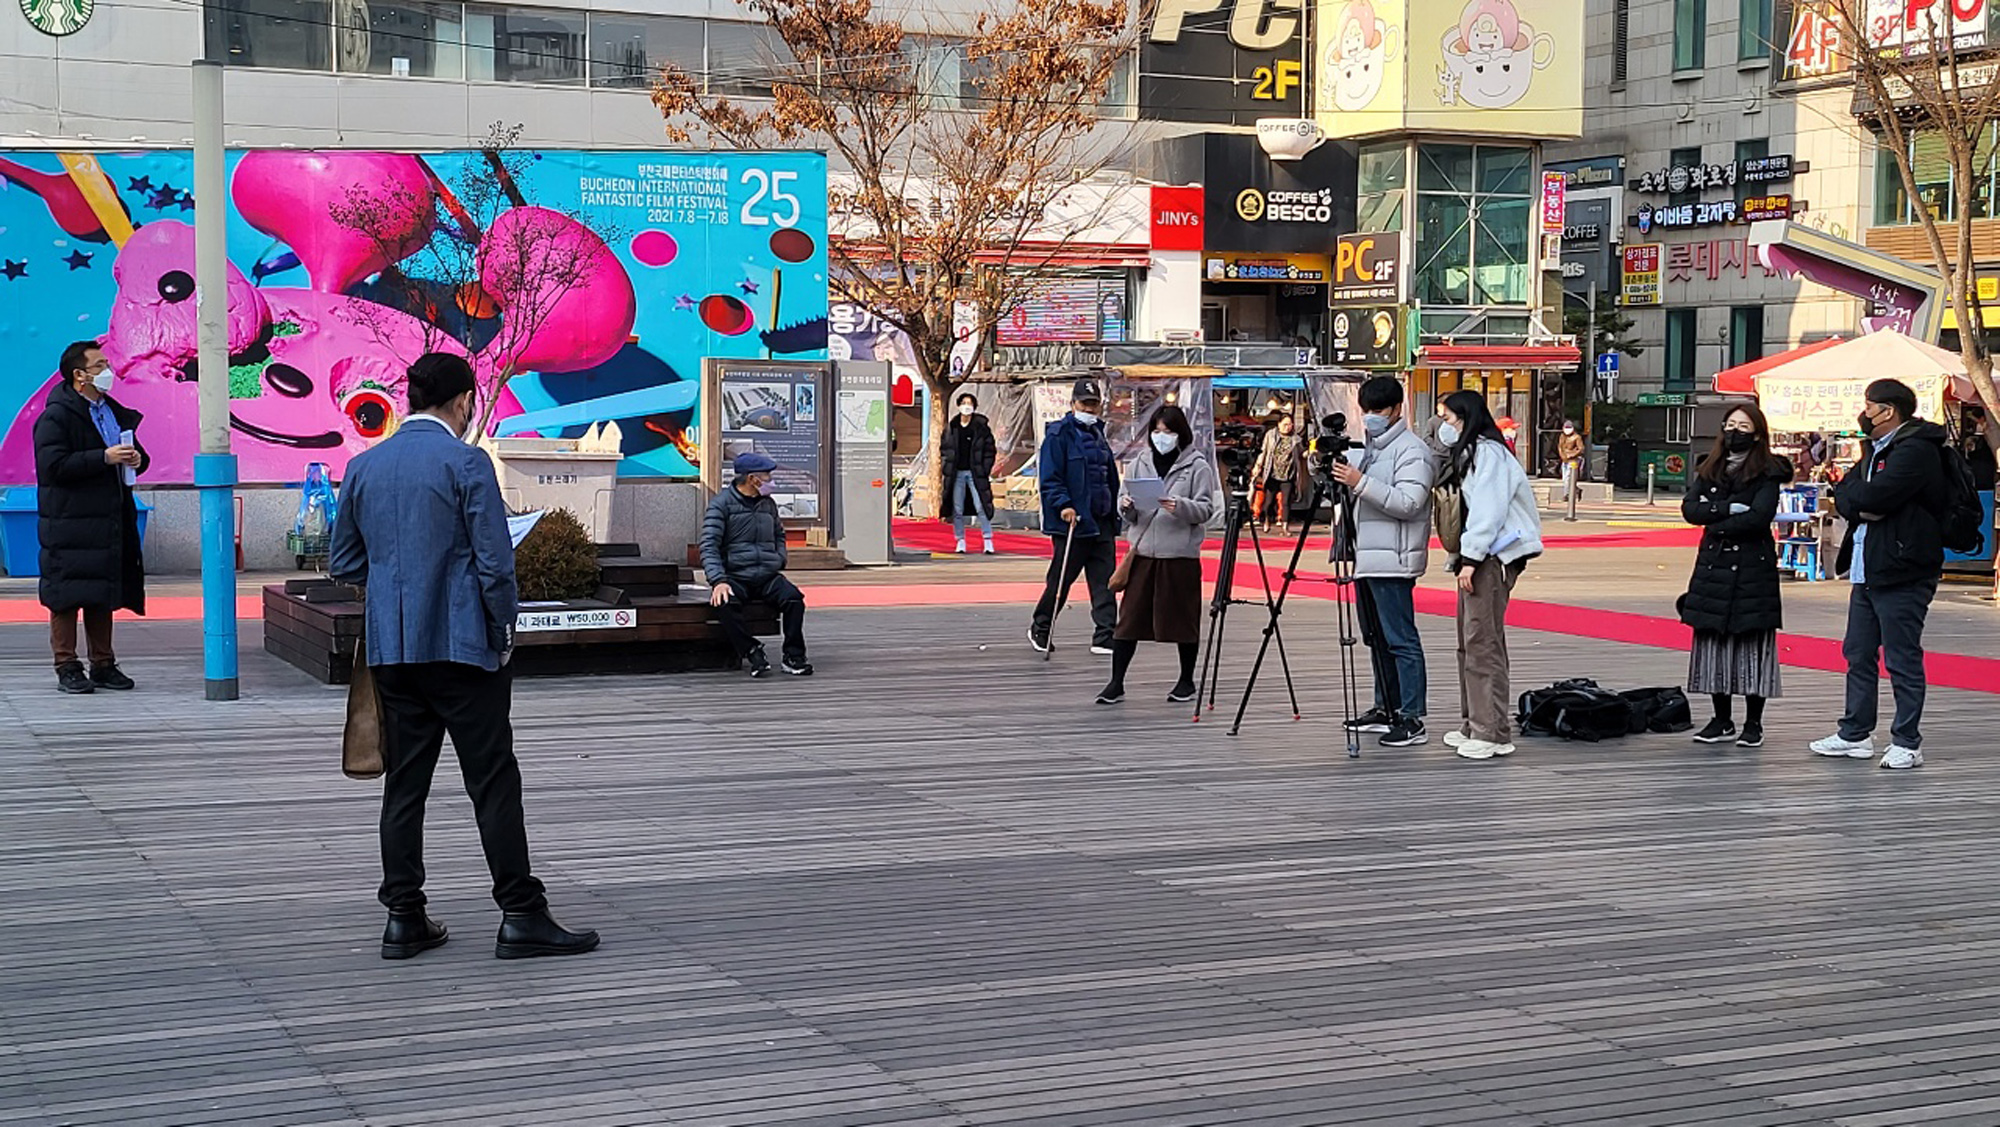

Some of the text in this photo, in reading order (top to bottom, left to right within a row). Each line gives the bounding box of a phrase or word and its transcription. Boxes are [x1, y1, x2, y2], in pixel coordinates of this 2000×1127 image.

[1789, 12, 1840, 66] 4F
[1252, 59, 1301, 101] 2F
[1259, 124, 1296, 134] COFFEE
[580, 177, 728, 196] BUCHEON INTERNATIONAL
[581, 192, 728, 210] FANTASTIC FILM FESTIVAL
[740, 168, 800, 229] 25
[1267, 190, 1318, 204] COFFEE
[1546, 181, 1561, 223] 부동산
[1266, 204, 1331, 222] BESCO
[1696, 202, 1737, 223] 감자탕
[1563, 223, 1598, 240] COFFEE
[1336, 239, 1394, 283] PC 2F
[1765, 384, 1779, 395] TV
[1791, 400, 1844, 421] 마스크
